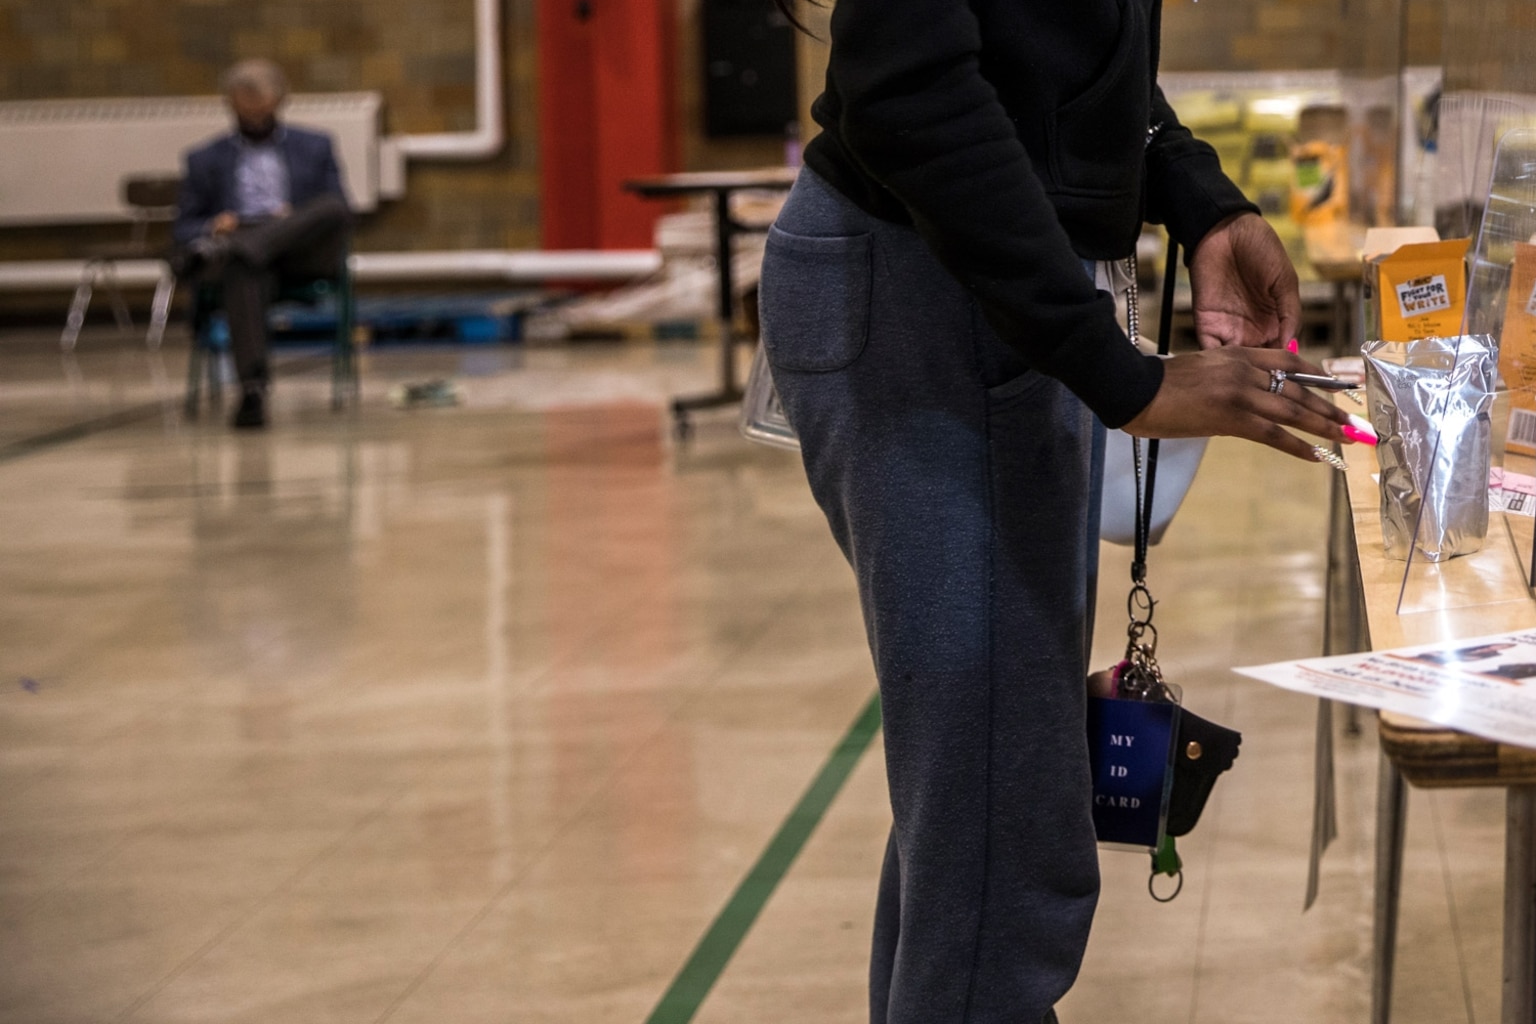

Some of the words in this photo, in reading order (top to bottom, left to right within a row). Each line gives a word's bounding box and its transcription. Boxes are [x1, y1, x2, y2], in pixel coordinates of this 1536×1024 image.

[1401, 287, 1425, 302] FIGHT
[1426, 283, 1444, 294] FOR
[1403, 295, 1446, 312] WRITE
[1110, 734, 1135, 748] MY
[1110, 765, 1128, 777] ID
[1095, 794, 1141, 809] CARD
